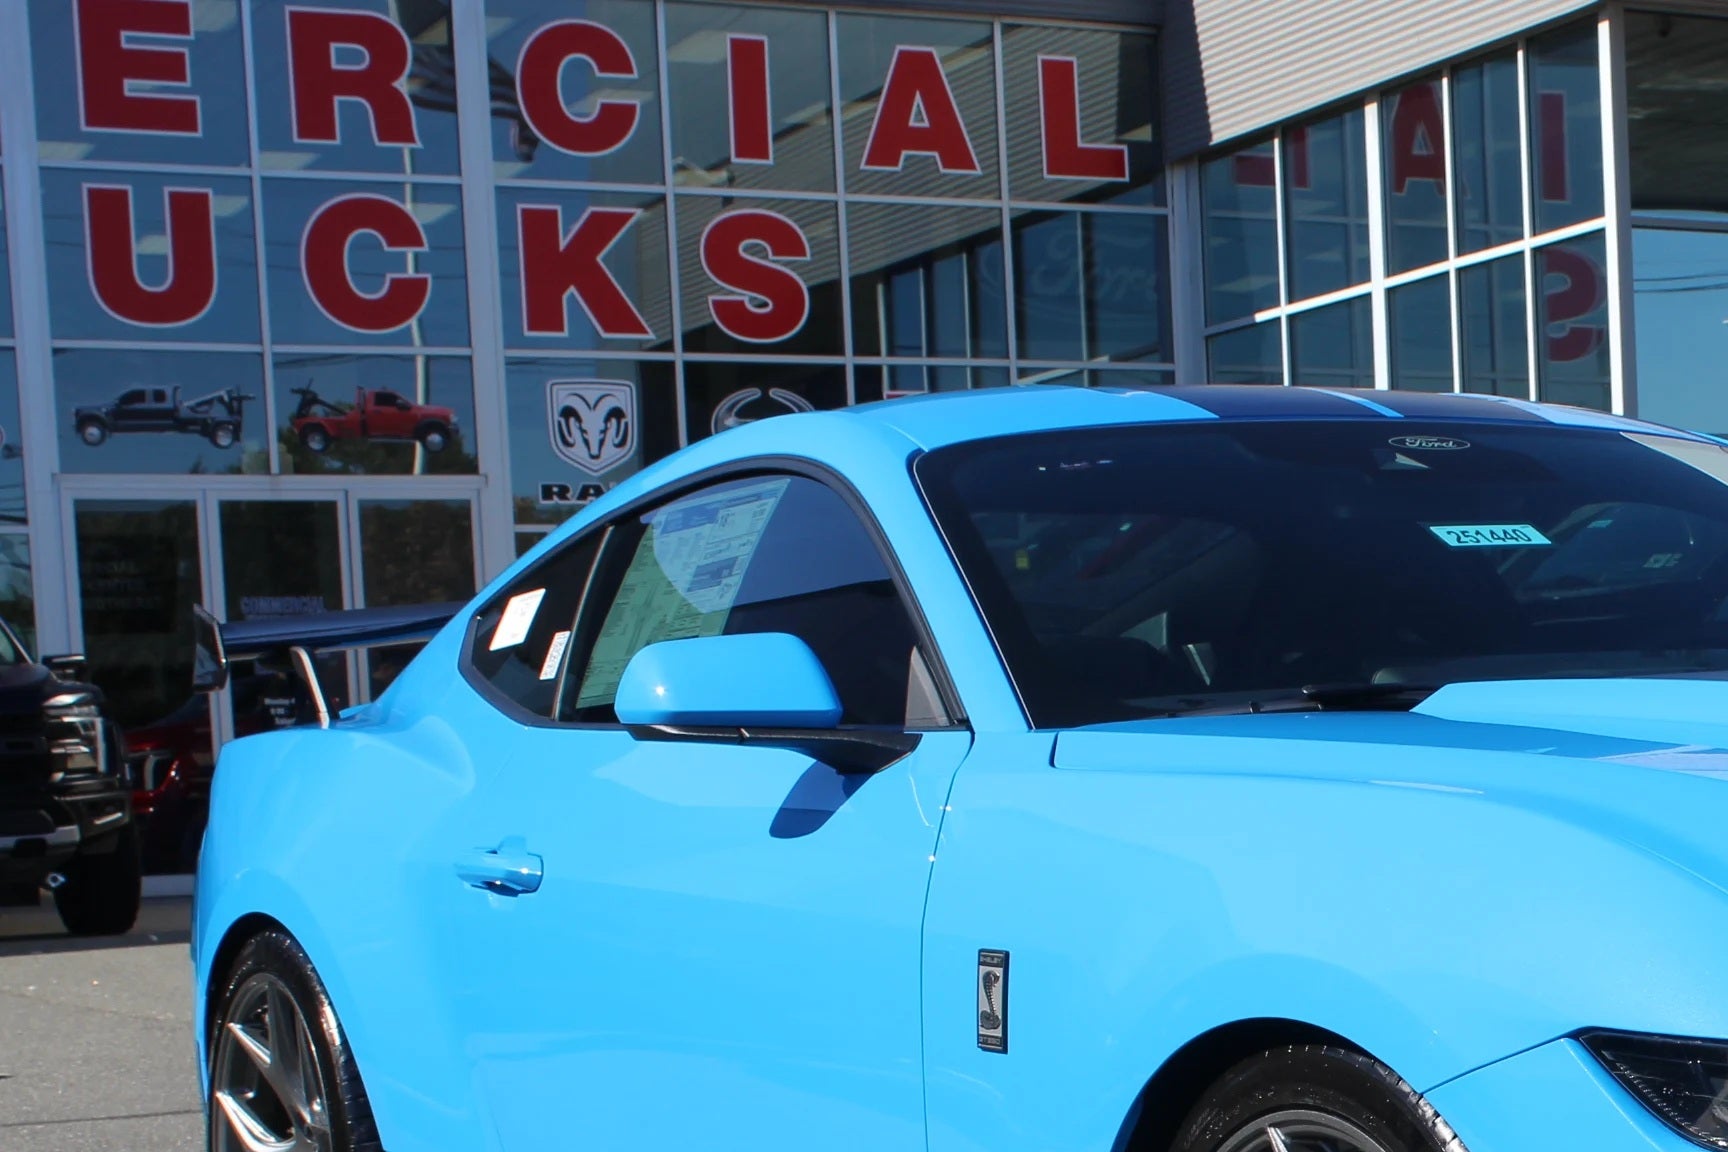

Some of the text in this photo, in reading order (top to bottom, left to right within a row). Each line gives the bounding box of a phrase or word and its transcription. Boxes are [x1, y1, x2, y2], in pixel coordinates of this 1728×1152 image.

[73, 0, 1129, 182] ERCIAL
[82, 183, 811, 343] UCKS
[1404, 437, 1458, 449] Ford
[538, 482, 617, 506] RA
[1446, 528, 1532, 544] 251440
